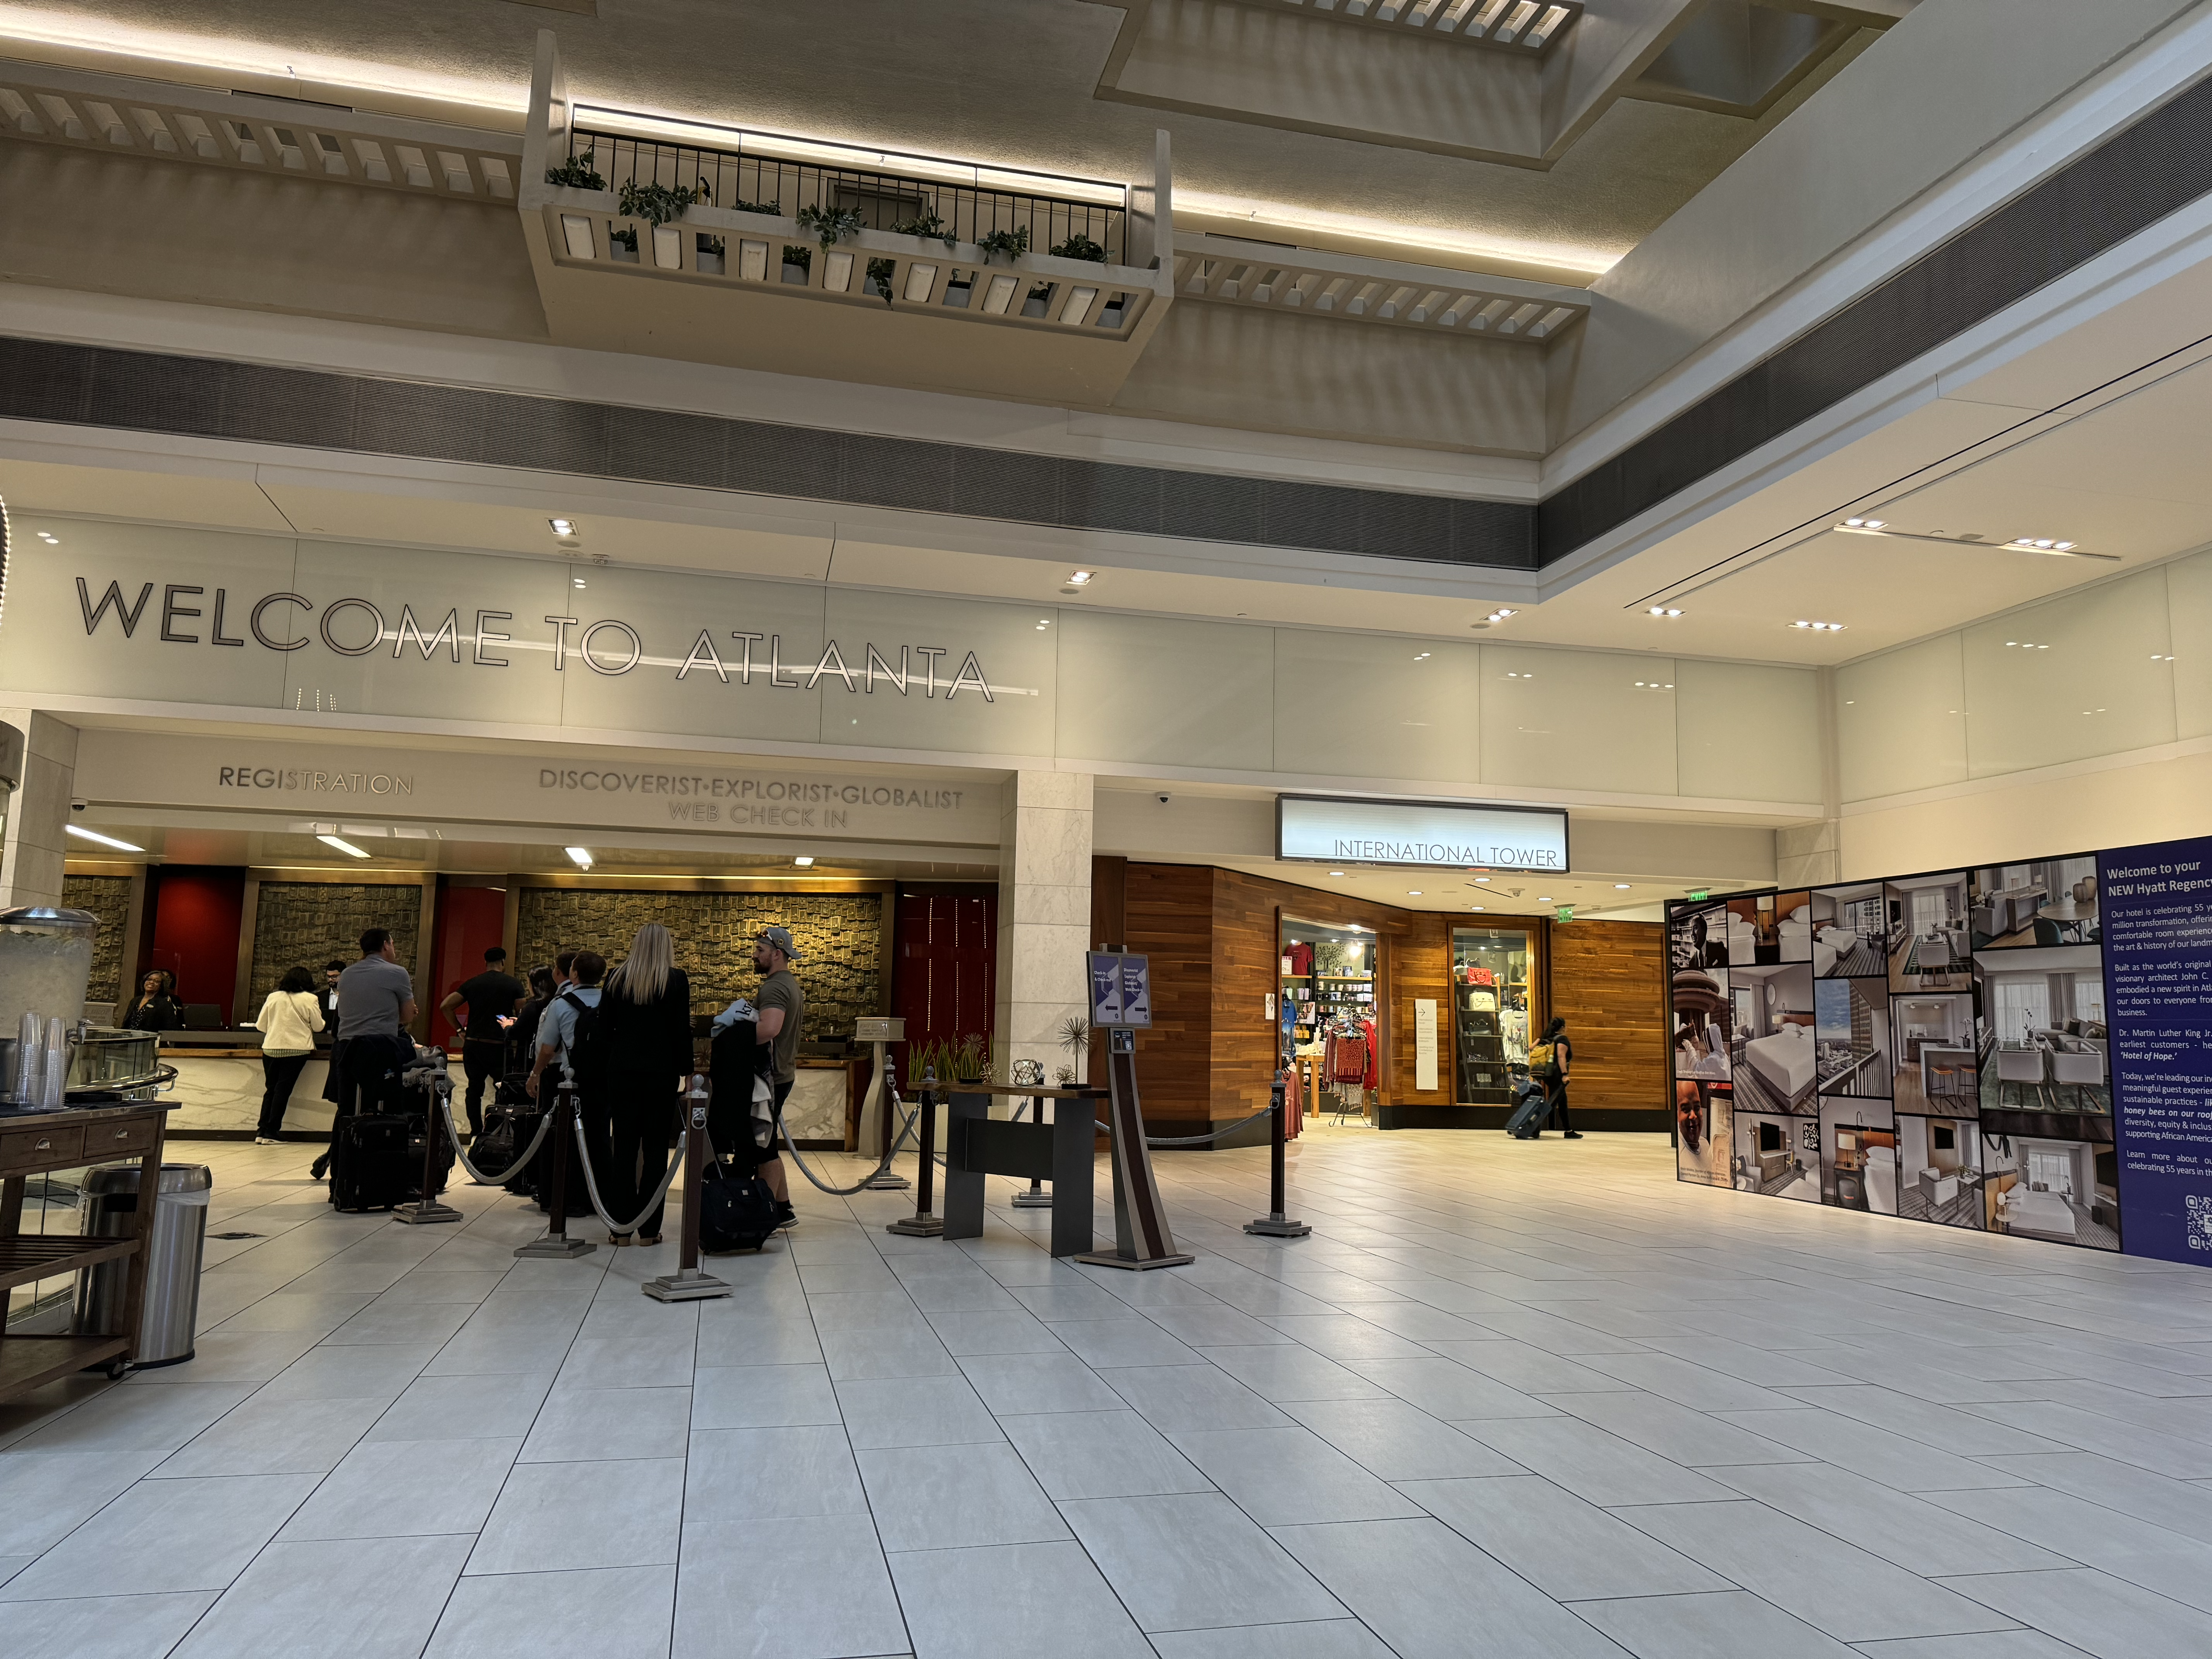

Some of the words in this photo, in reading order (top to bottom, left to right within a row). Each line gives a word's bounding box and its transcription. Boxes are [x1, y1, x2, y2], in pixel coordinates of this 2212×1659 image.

[76, 577, 512, 666] WELCOME
[545, 617, 641, 675] TO
[676, 629, 994, 702] ATLANTA
[219, 767, 413, 795] REGISTRATION
[670, 802, 720, 824] WEB
[731, 805, 815, 826] CHECK
[824, 809, 847, 828] IN
[1334, 840, 1484, 863] INTERNATIONAL
[1491, 847, 1556, 867] TOWER
[2107, 867, 2157, 879] Welcome
[2160, 864, 2171, 874] to
[2174, 862, 2200, 874] your
[2109, 884, 2134, 896] NEW
[2137, 882, 2166, 895] Hyatt
[1691, 892, 1705, 902] EXIT
[2154, 905, 2192, 914] celebrating
[2136, 917, 2188, 927] transformation,
[2113, 931, 2152, 940] comfortable
[2177, 927, 2212, 937] experienc
[2185, 960, 2211, 970] original
[2116, 985, 2149, 993] embodied
[2173, 984, 2191, 994] spirit
[2186, 1029, 2201, 1038] King
[2144, 1052, 2152, 1061] of
[2121, 1072, 2143, 1081] Today,
[2165, 1073, 2190, 1083] leading
[2123, 1084, 2160, 1093] meaningful
[2183, 1087, 2212, 1095] experie
[2124, 1106, 2145, 1116] honey
[2148, 1107, 2165, 1115] bees
[2125, 1118, 2156, 1128] diversity,
[2158, 1121, 2180, 1130] equity
[2126, 1131, 2160, 1140] supporting
[2161, 1132, 2185, 1140] African
[2177, 1154, 2198, 1163] about
[2128, 1162, 2165, 1173] celebrating
